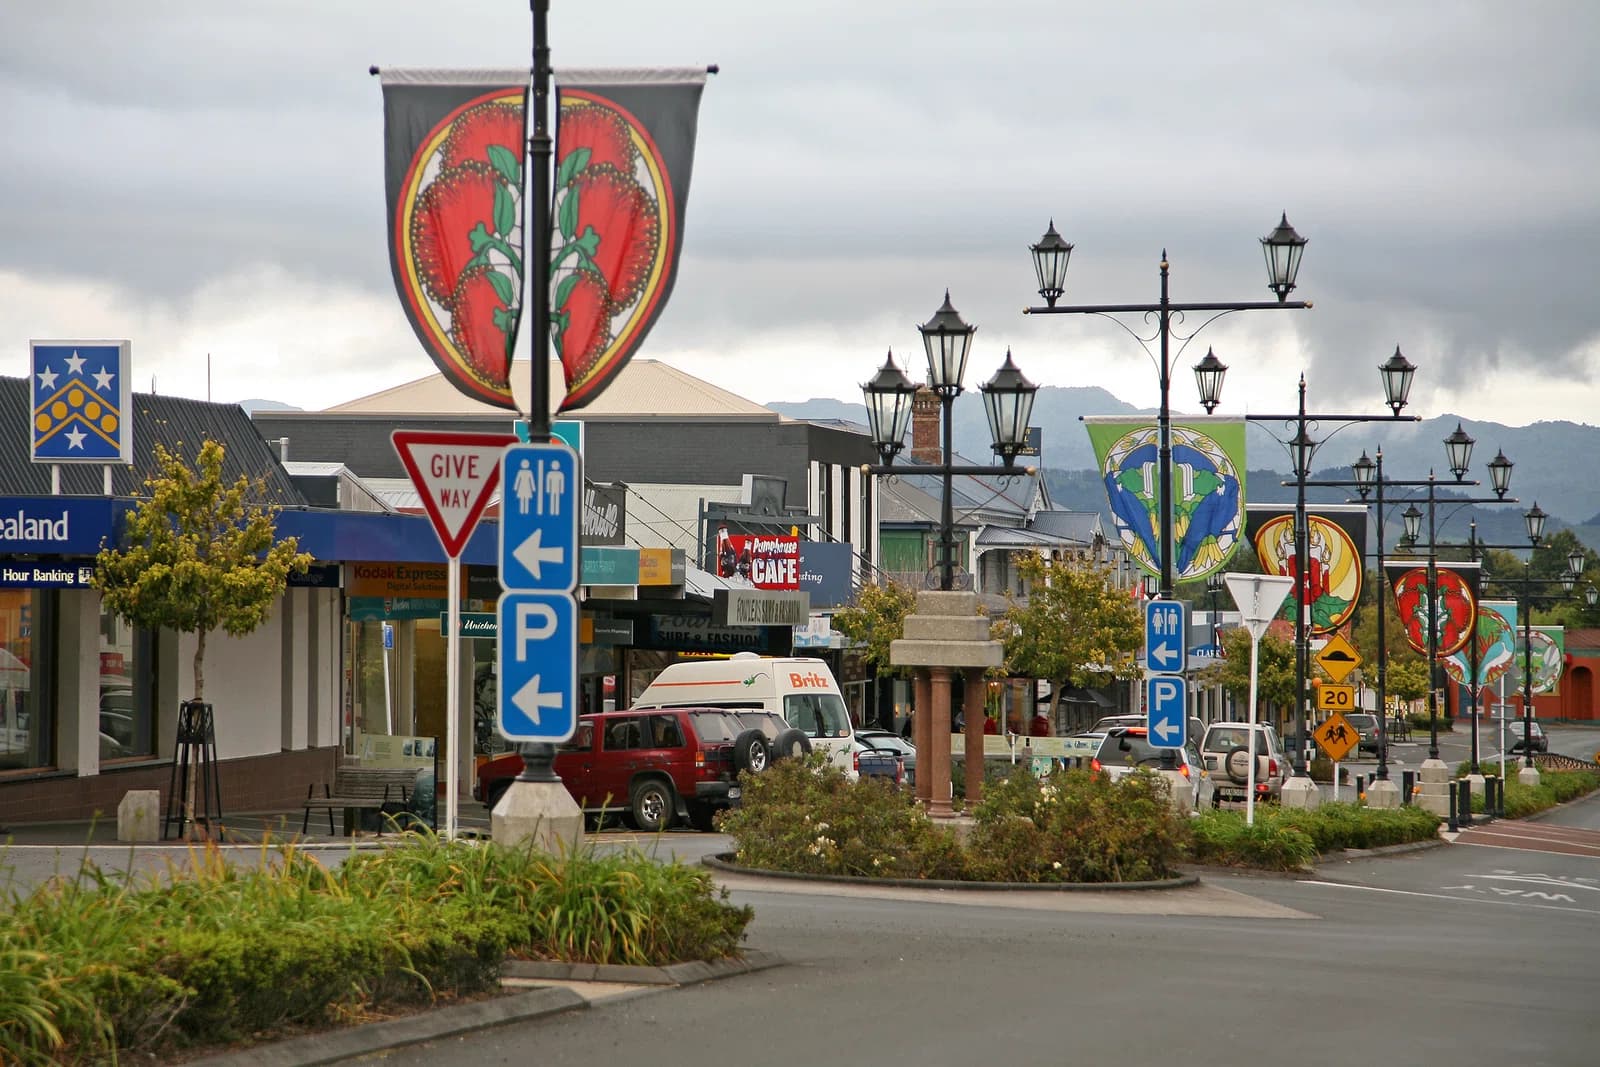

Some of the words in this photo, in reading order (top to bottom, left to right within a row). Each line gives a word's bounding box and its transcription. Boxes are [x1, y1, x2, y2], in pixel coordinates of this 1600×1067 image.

[430, 454, 480, 479] GIVE
[439, 488, 471, 509] WAY
[752, 537, 798, 556] Pumphouse
[3, 568, 31, 582] Hour
[34, 569, 75, 584] Banking
[353, 566, 395, 580] Kodak
[396, 567, 448, 583] Express
[752, 558, 798, 584] CAFE
[515, 602, 559, 662] P
[707, 633, 761, 647] FASHION
[789, 671, 829, 688] Britz
[1155, 682, 1177, 711] P
[1325, 690, 1348, 705] 20
